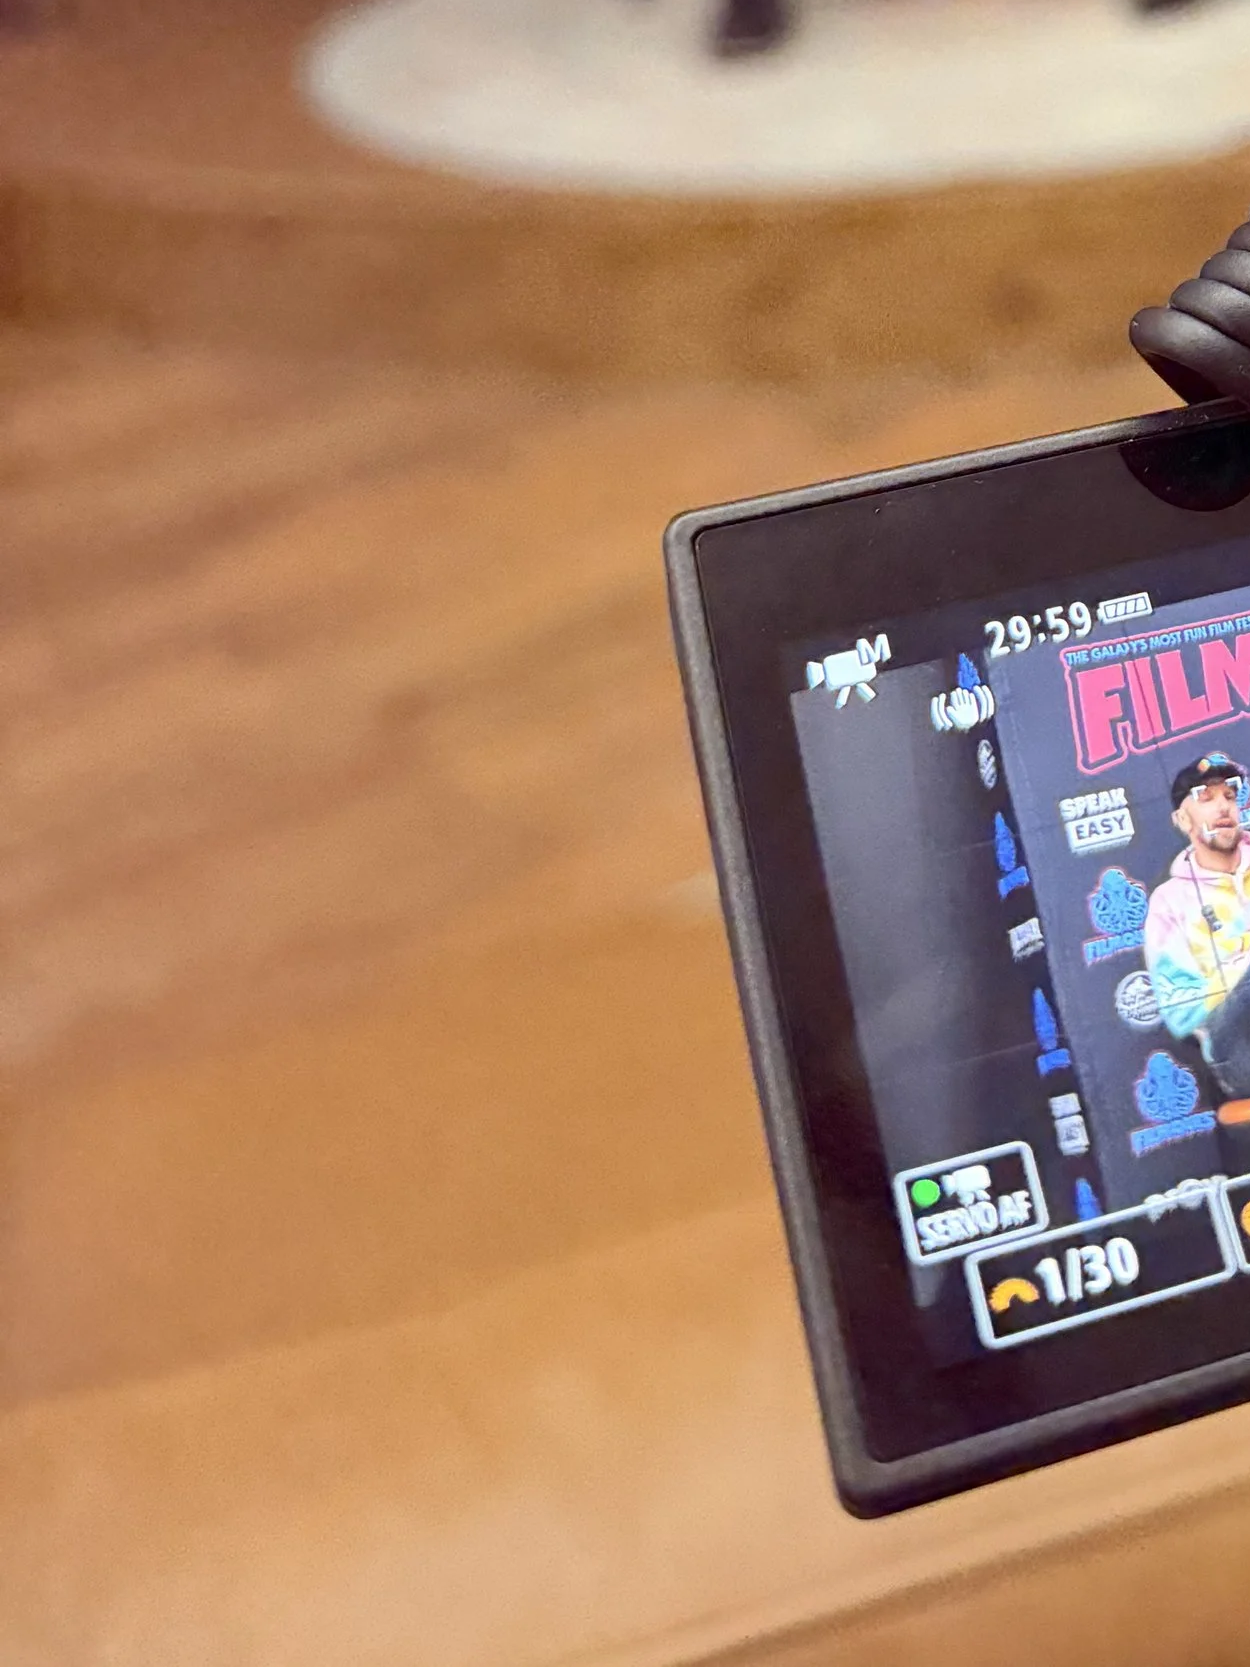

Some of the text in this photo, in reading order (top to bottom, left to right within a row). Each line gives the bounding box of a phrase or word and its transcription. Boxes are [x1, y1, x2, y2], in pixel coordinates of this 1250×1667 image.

[856, 633, 892, 666] M
[984, 601, 1093, 658] 29:59
[1066, 650, 1090, 666] THE
[1149, 630, 1182, 650] MOST
[1183, 625, 1208, 643] FUN
[1208, 620, 1235, 637] FILM
[1059, 787, 1129, 823] SPEAK
[1075, 813, 1126, 840] EASY
[916, 1189, 1032, 1252] SERVO AF
[1034, 1236, 1140, 1306] 1/30
